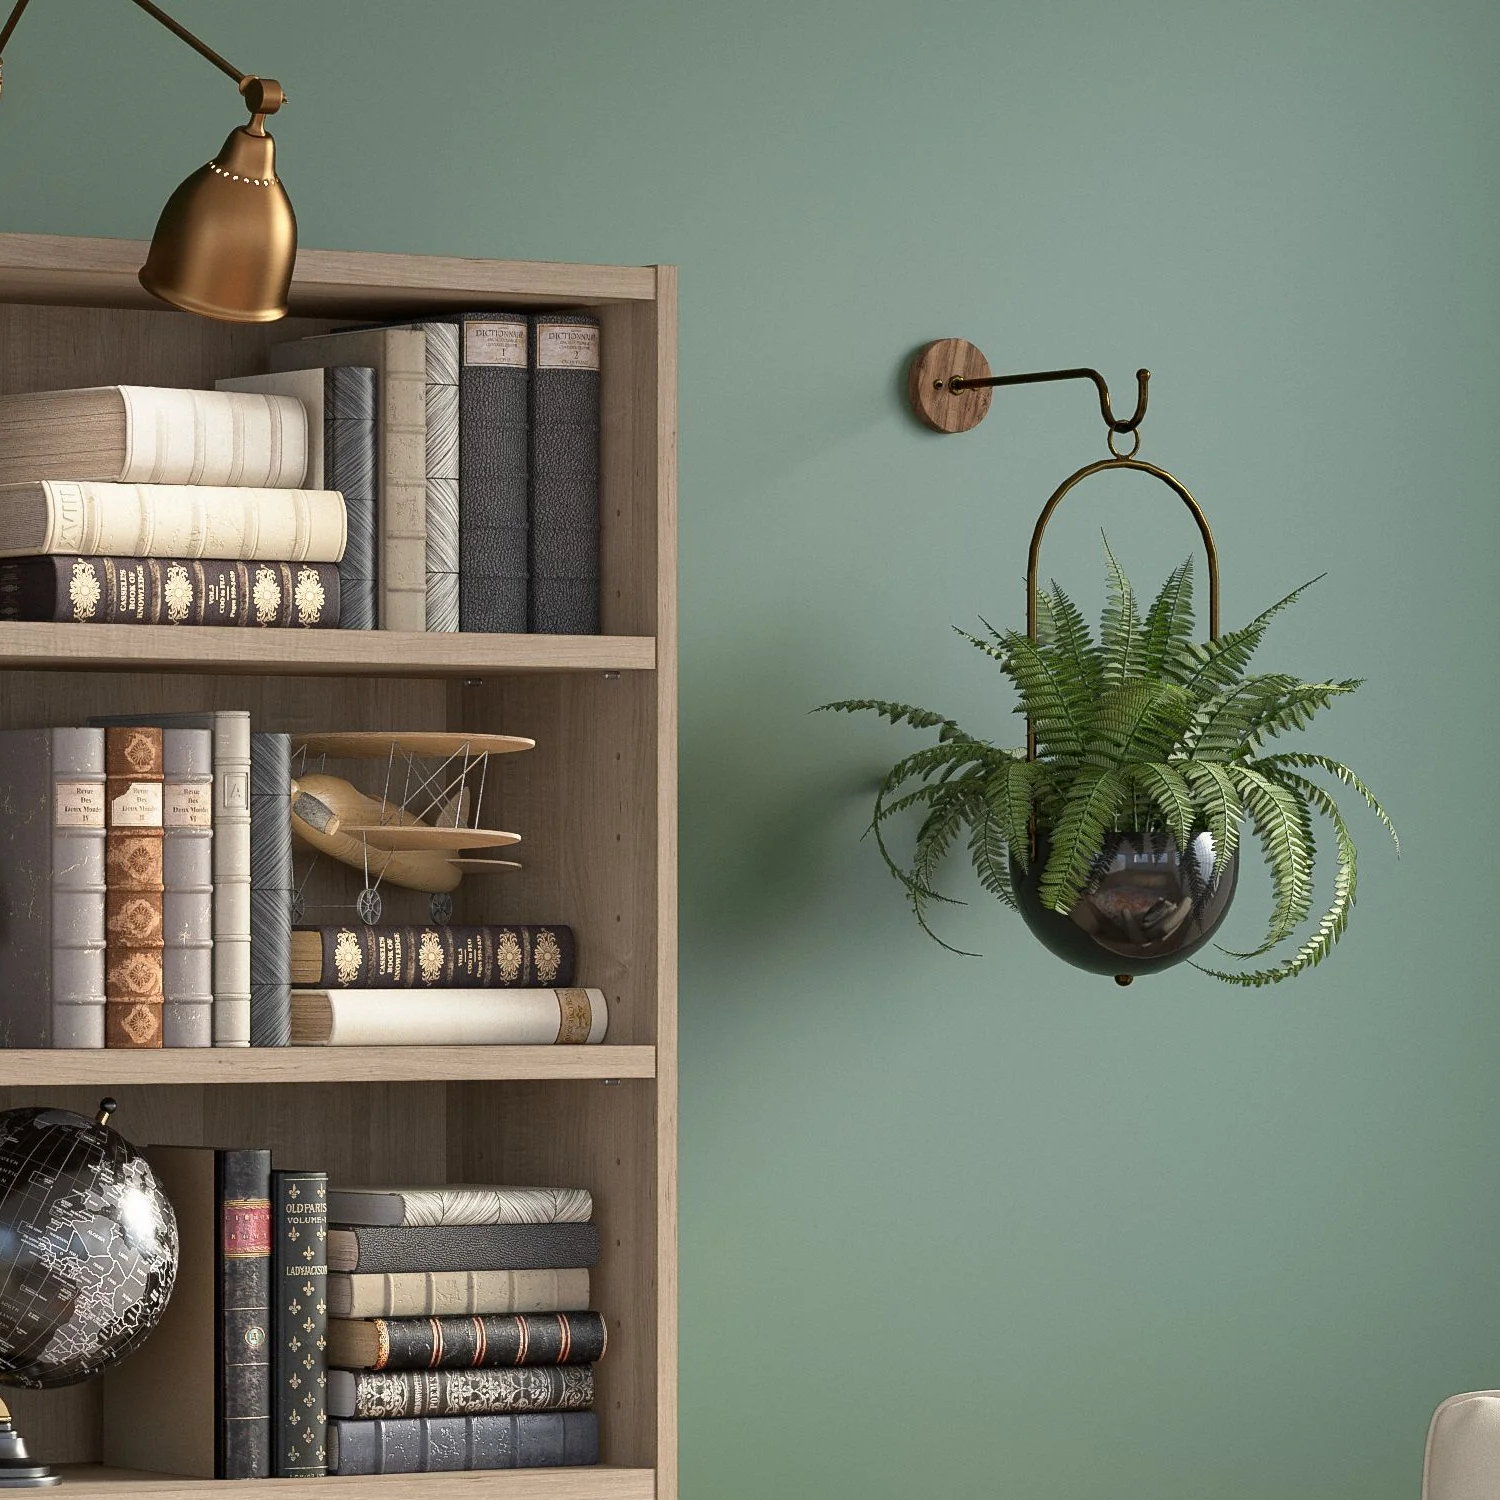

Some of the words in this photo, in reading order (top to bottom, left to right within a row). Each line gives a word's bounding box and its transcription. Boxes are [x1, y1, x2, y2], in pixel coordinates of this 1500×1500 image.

[573, 350, 580, 360] 2
[128, 571, 136, 586] OF
[128, 586, 136, 610] BOOK
[136, 565, 145, 619] KNOWLEDGE
[64, 805, 81, 813] Deux
[80, 796, 91, 804] Des
[386, 950, 394, 973] BOOK
[393, 931, 402, 980] KNOWLEDGE
[285, 1203, 303, 1214] OLD
[303, 1203, 327, 1214] PARIS
[429, 1376, 438, 1409] POEMS
